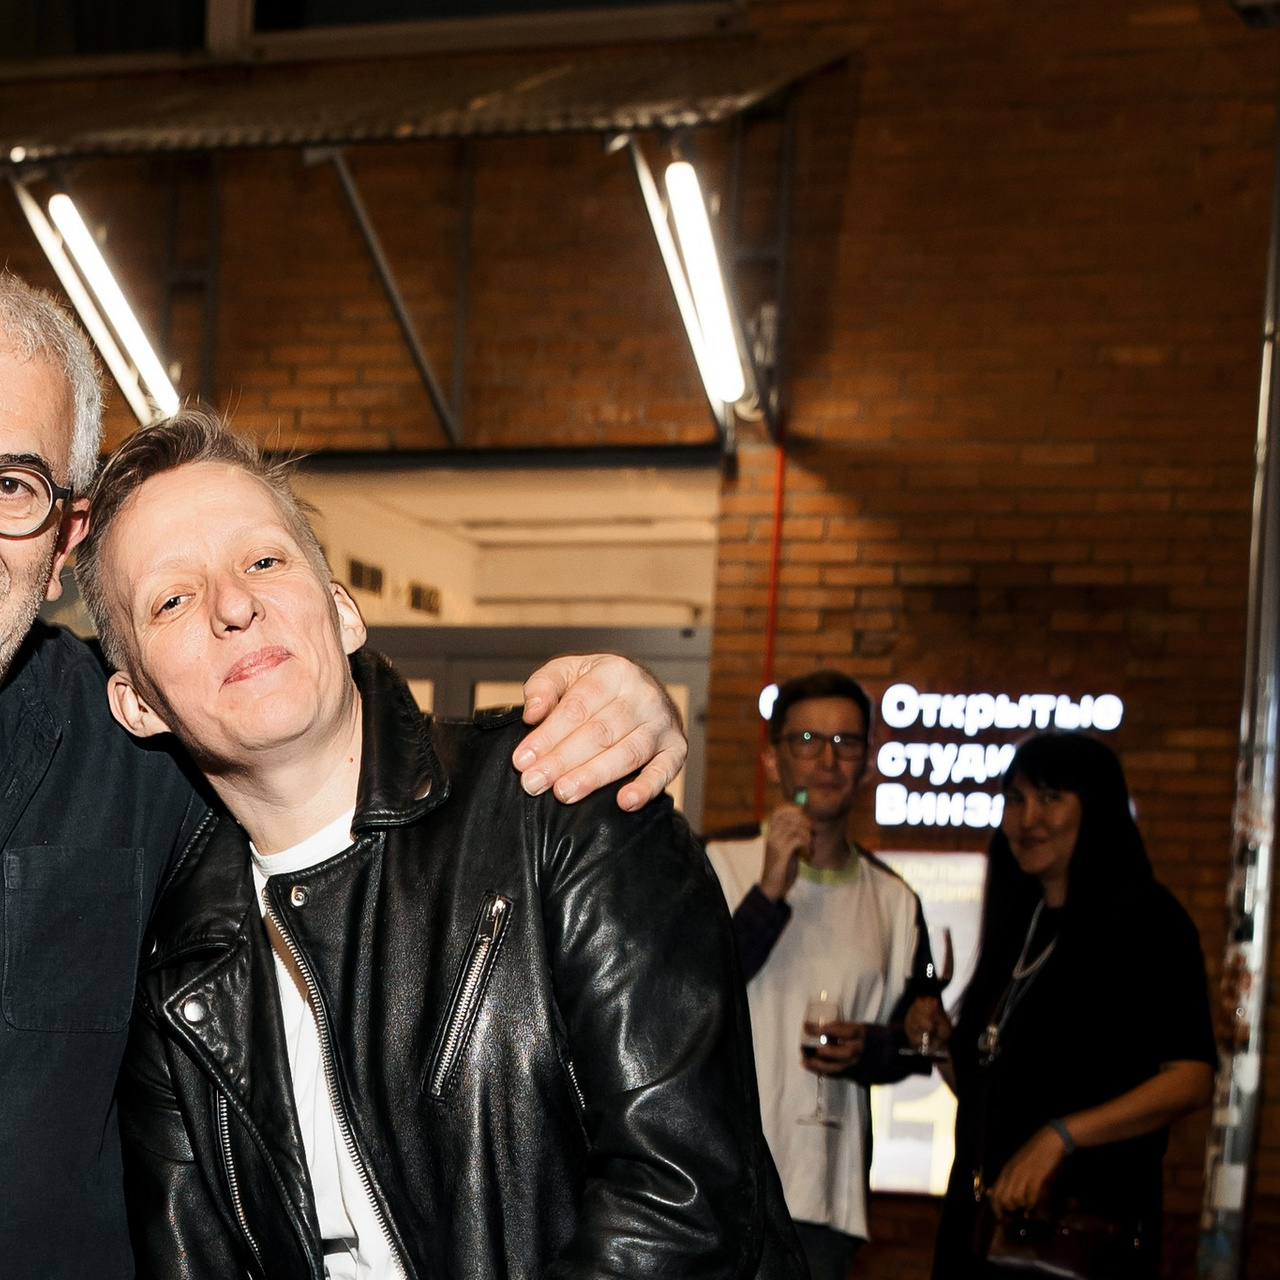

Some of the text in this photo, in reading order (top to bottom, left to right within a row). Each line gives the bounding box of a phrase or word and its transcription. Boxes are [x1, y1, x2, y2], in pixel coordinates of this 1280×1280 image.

[881, 683, 1123, 736] Открытые
[877, 741, 1015, 785] студи
[875, 783, 1004, 827] Винз
